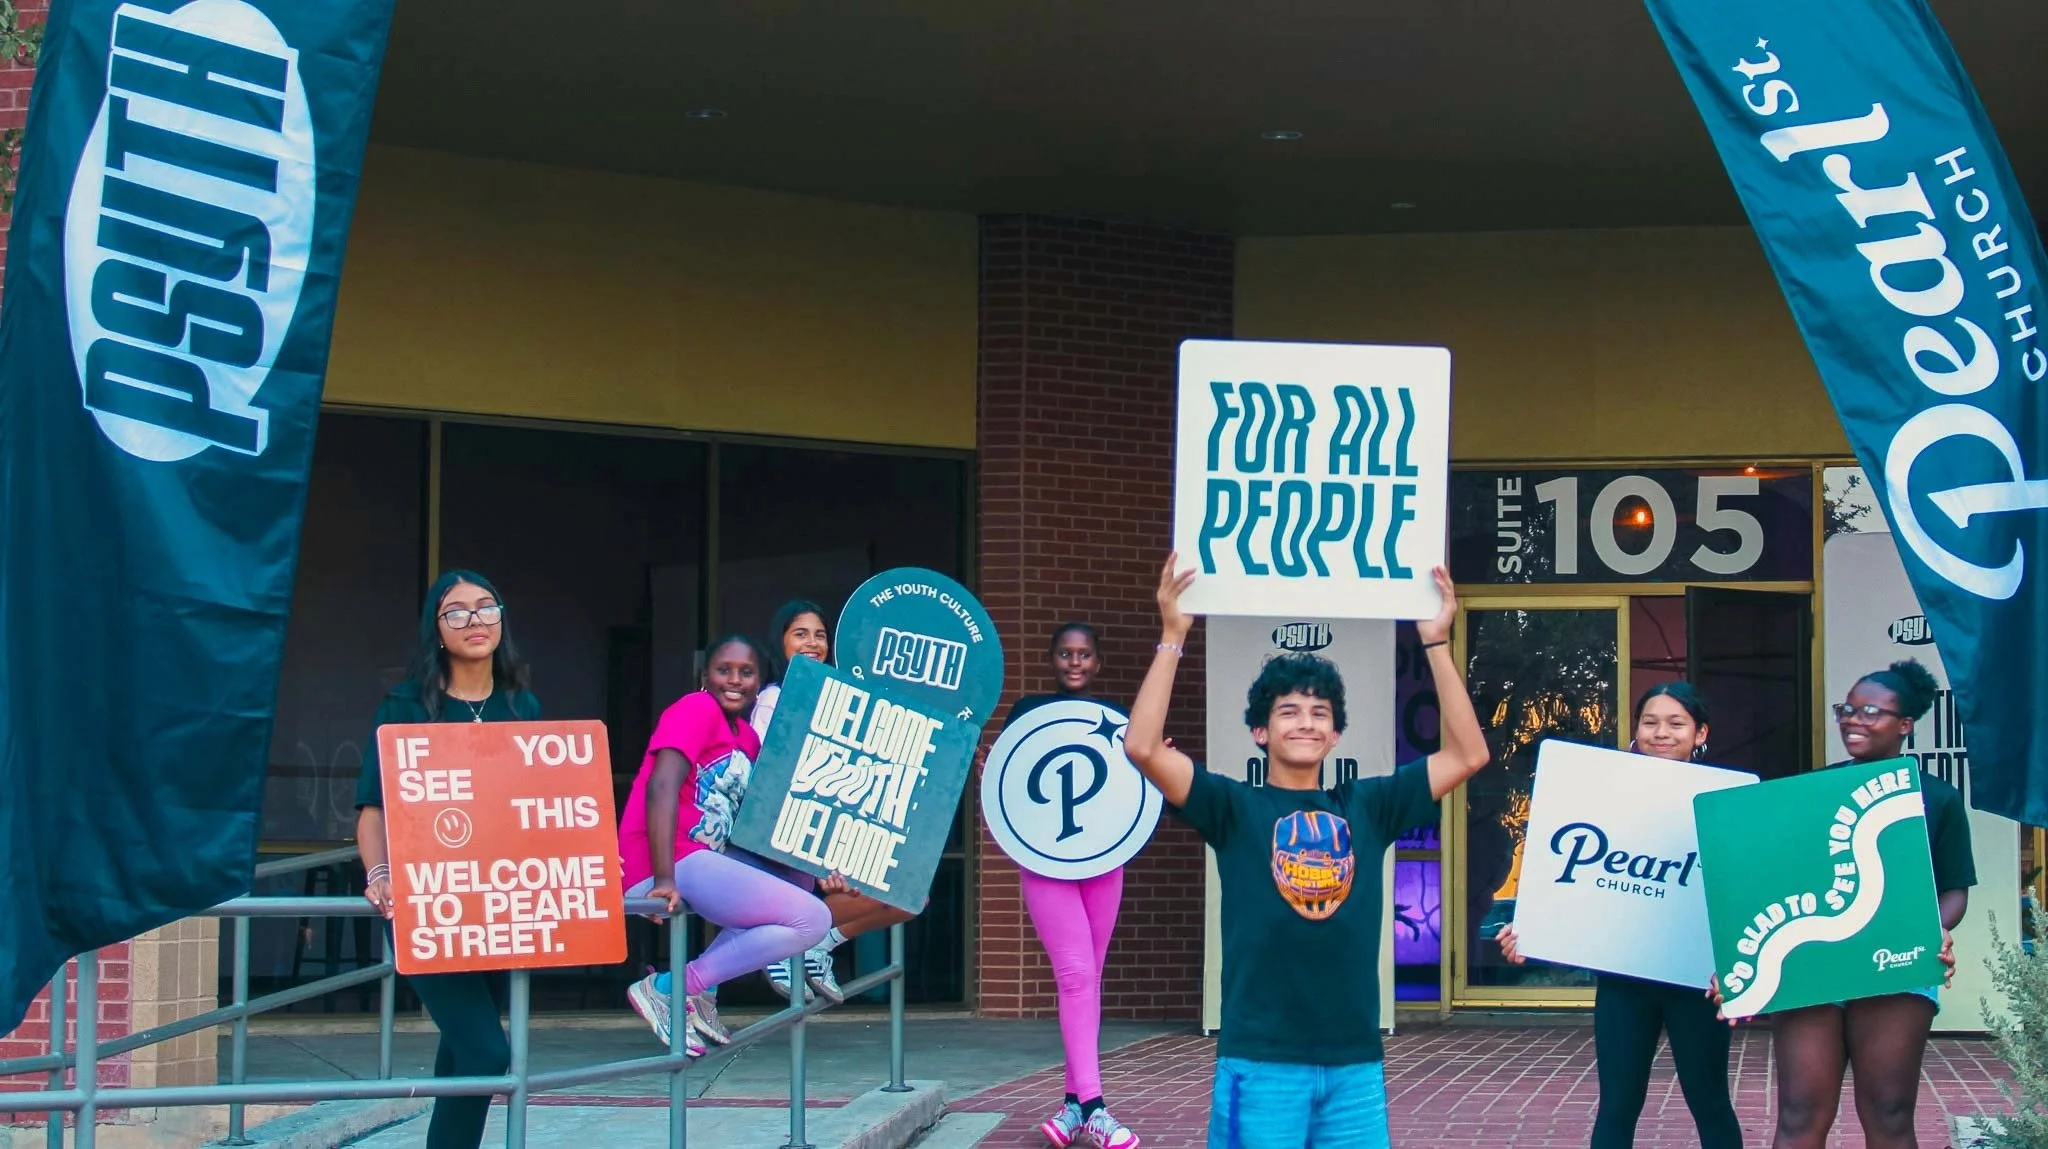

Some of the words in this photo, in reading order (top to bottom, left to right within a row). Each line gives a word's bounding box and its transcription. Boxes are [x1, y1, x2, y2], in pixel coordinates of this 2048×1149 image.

[1935, 146, 2047, 382] CHURCH
[1760, 102, 2048, 600] Pearl
[1207, 381, 1316, 474] FOR
[1329, 385, 1419, 477] ALL
[1199, 478, 1417, 580] PEOPLE
[1497, 477, 1522, 575] SUITE
[1535, 475, 1764, 575] 105
[870, 588, 894, 608] THE
[894, 584, 938, 598] YOUTH
[940, 593, 984, 643] CULTURE
[1892, 617, 1932, 643] PSYT
[810, 676, 944, 776] WELCOME
[396, 737, 430, 769] IF
[513, 734, 594, 766] YOU
[399, 769, 474, 803] SEE
[790, 746, 922, 830] YOUTH
[1027, 744, 1108, 843] P
[1851, 768, 1911, 809] HERE
[511, 796, 600, 830] THIS
[1829, 805, 1858, 856] YOU
[771, 792, 907, 892] WELCOME
[1550, 822, 1698, 887] Pearl
[405, 856, 606, 895] WELCOME
[1596, 878, 1665, 899] CHURCH
[1825, 861, 1856, 911] SEE
[408, 893, 463, 927] TO
[484, 887, 609, 924] PEARL
[1737, 902, 1787, 956] GLAD
[1785, 892, 1817, 917] TO
[411, 920, 565, 960] STREET.
[1872, 946, 1919, 972] Pearl
[1889, 961, 1913, 969] CHURCH
[1723, 961, 1754, 994] SO
